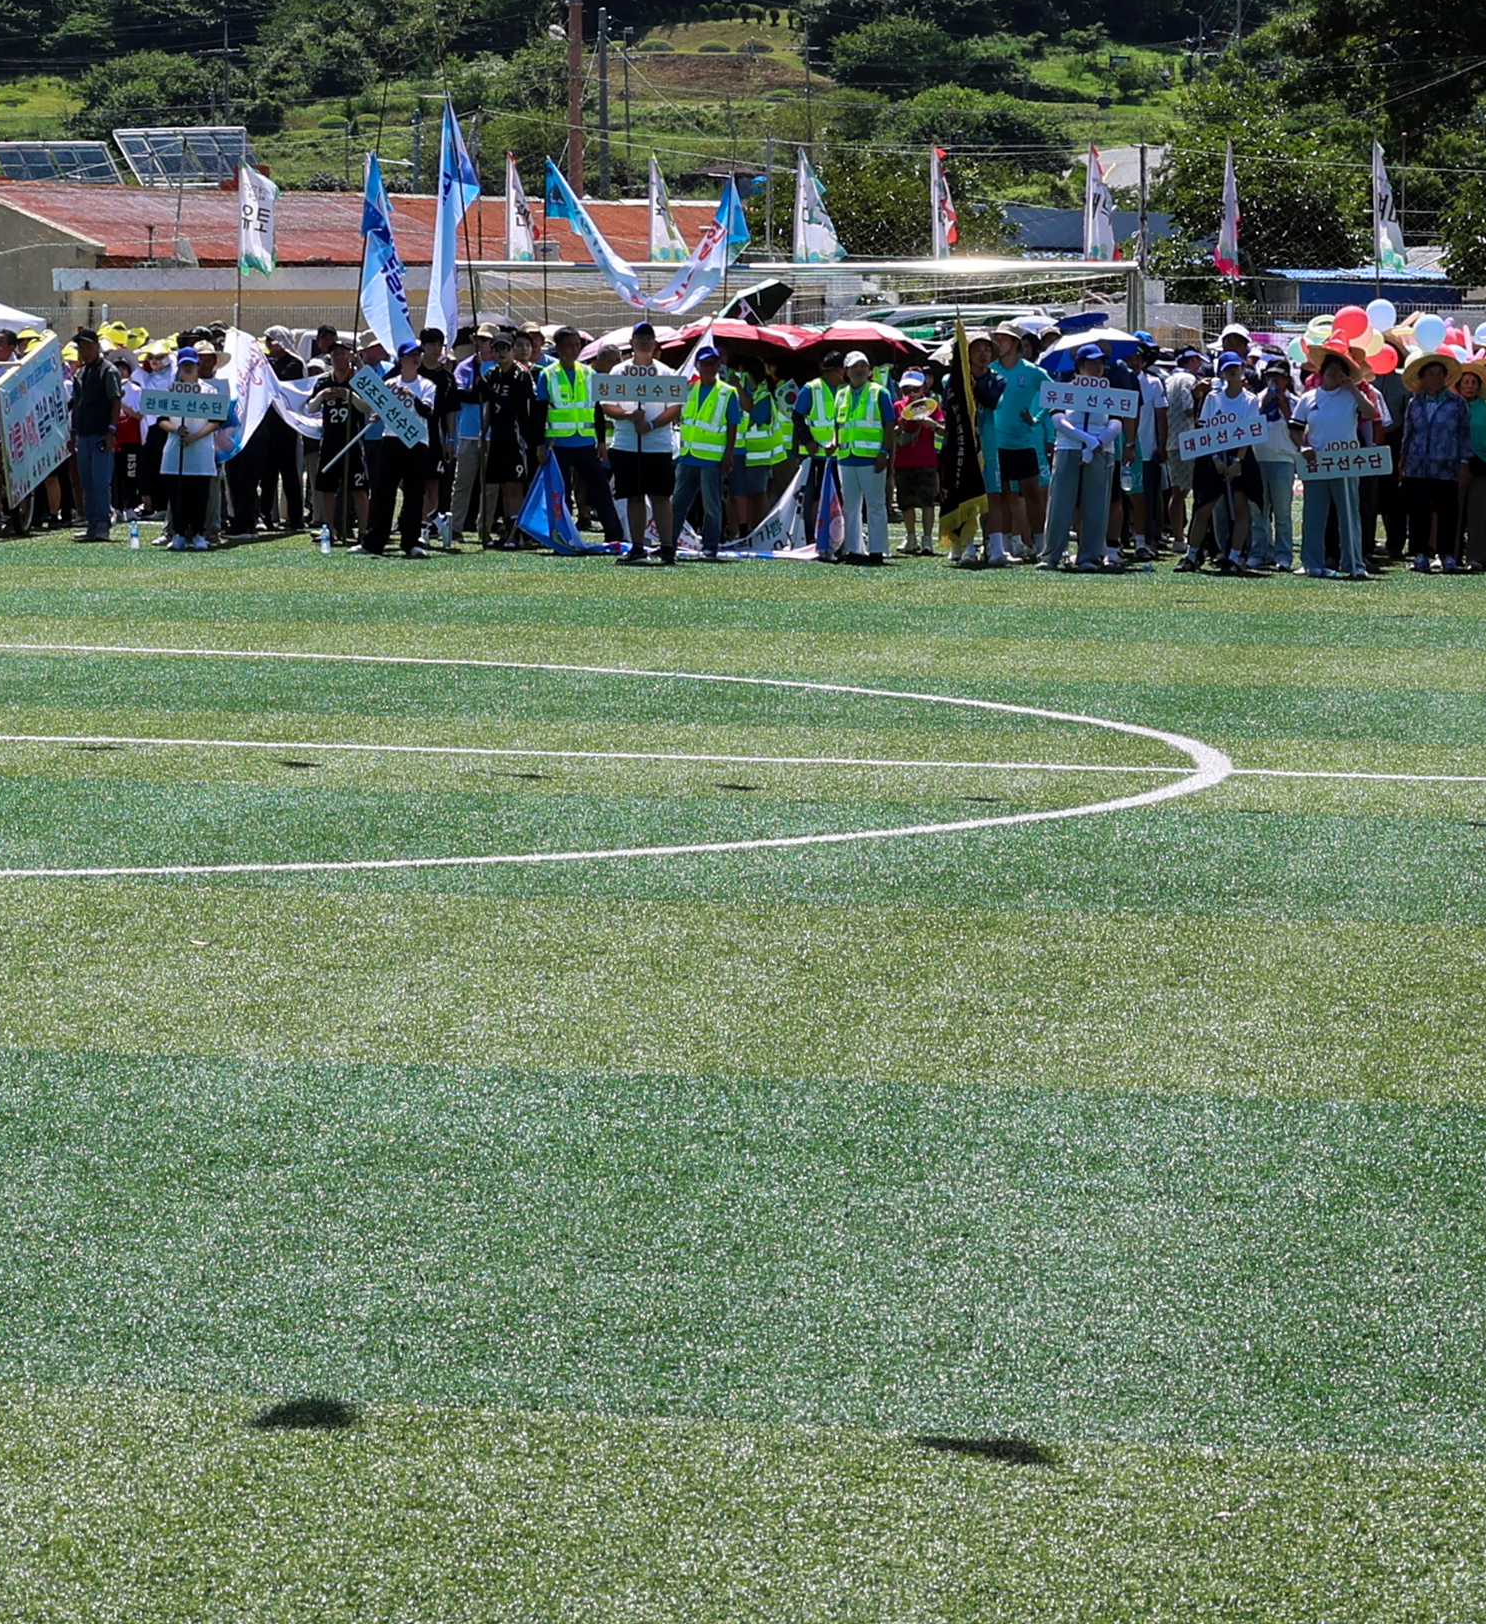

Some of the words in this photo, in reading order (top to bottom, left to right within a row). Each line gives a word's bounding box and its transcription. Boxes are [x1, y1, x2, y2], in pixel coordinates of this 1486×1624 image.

[242, 204, 271, 233] 유토
[622, 366, 657, 376] JODO
[169, 384, 201, 394] JODO
[598, 383, 626, 396] 창리
[636, 384, 681, 397] 선수단
[1073, 378, 1108, 389] JODO
[145, 397, 180, 411] 관매도
[186, 400, 222, 414] 선수단
[356, 375, 388, 410] 상조도
[385, 406, 420, 442] 선수단
[1046, 391, 1074, 405] 유토
[1086, 395, 1132, 412] 선수단
[330, 408, 349, 423] 29
[1205, 413, 1236, 428] JODO
[1324, 440, 1358, 452] JODO
[516, 465, 523, 477] 9
